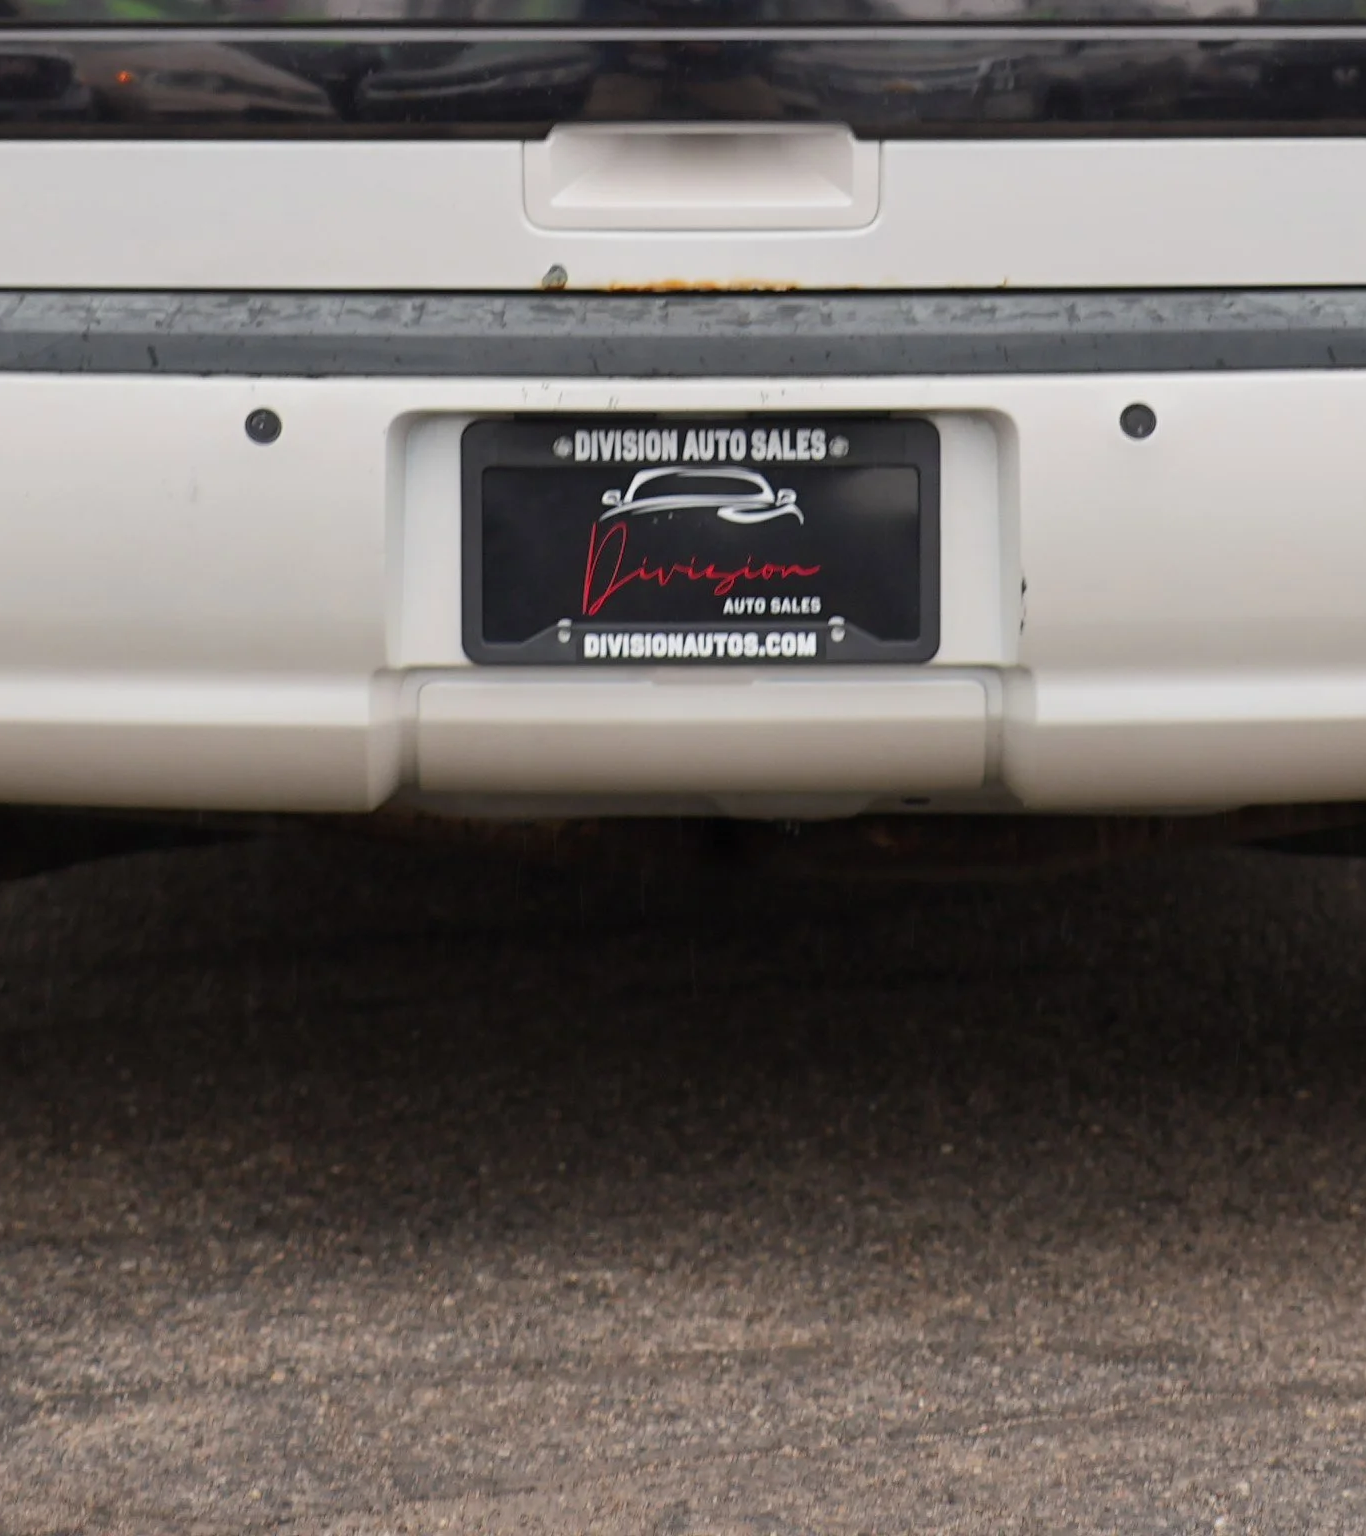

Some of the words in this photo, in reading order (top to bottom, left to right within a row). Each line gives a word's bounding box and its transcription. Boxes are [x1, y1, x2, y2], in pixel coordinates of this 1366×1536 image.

[574, 429, 677, 461] DIVISION
[683, 429, 746, 461] AUTO
[751, 428, 827, 461] SALES
[582, 521, 821, 617] Division
[722, 597, 767, 615] AUTO
[770, 597, 822, 614] SALES
[583, 632, 817, 658] DIVISIONAUTOS.COM
